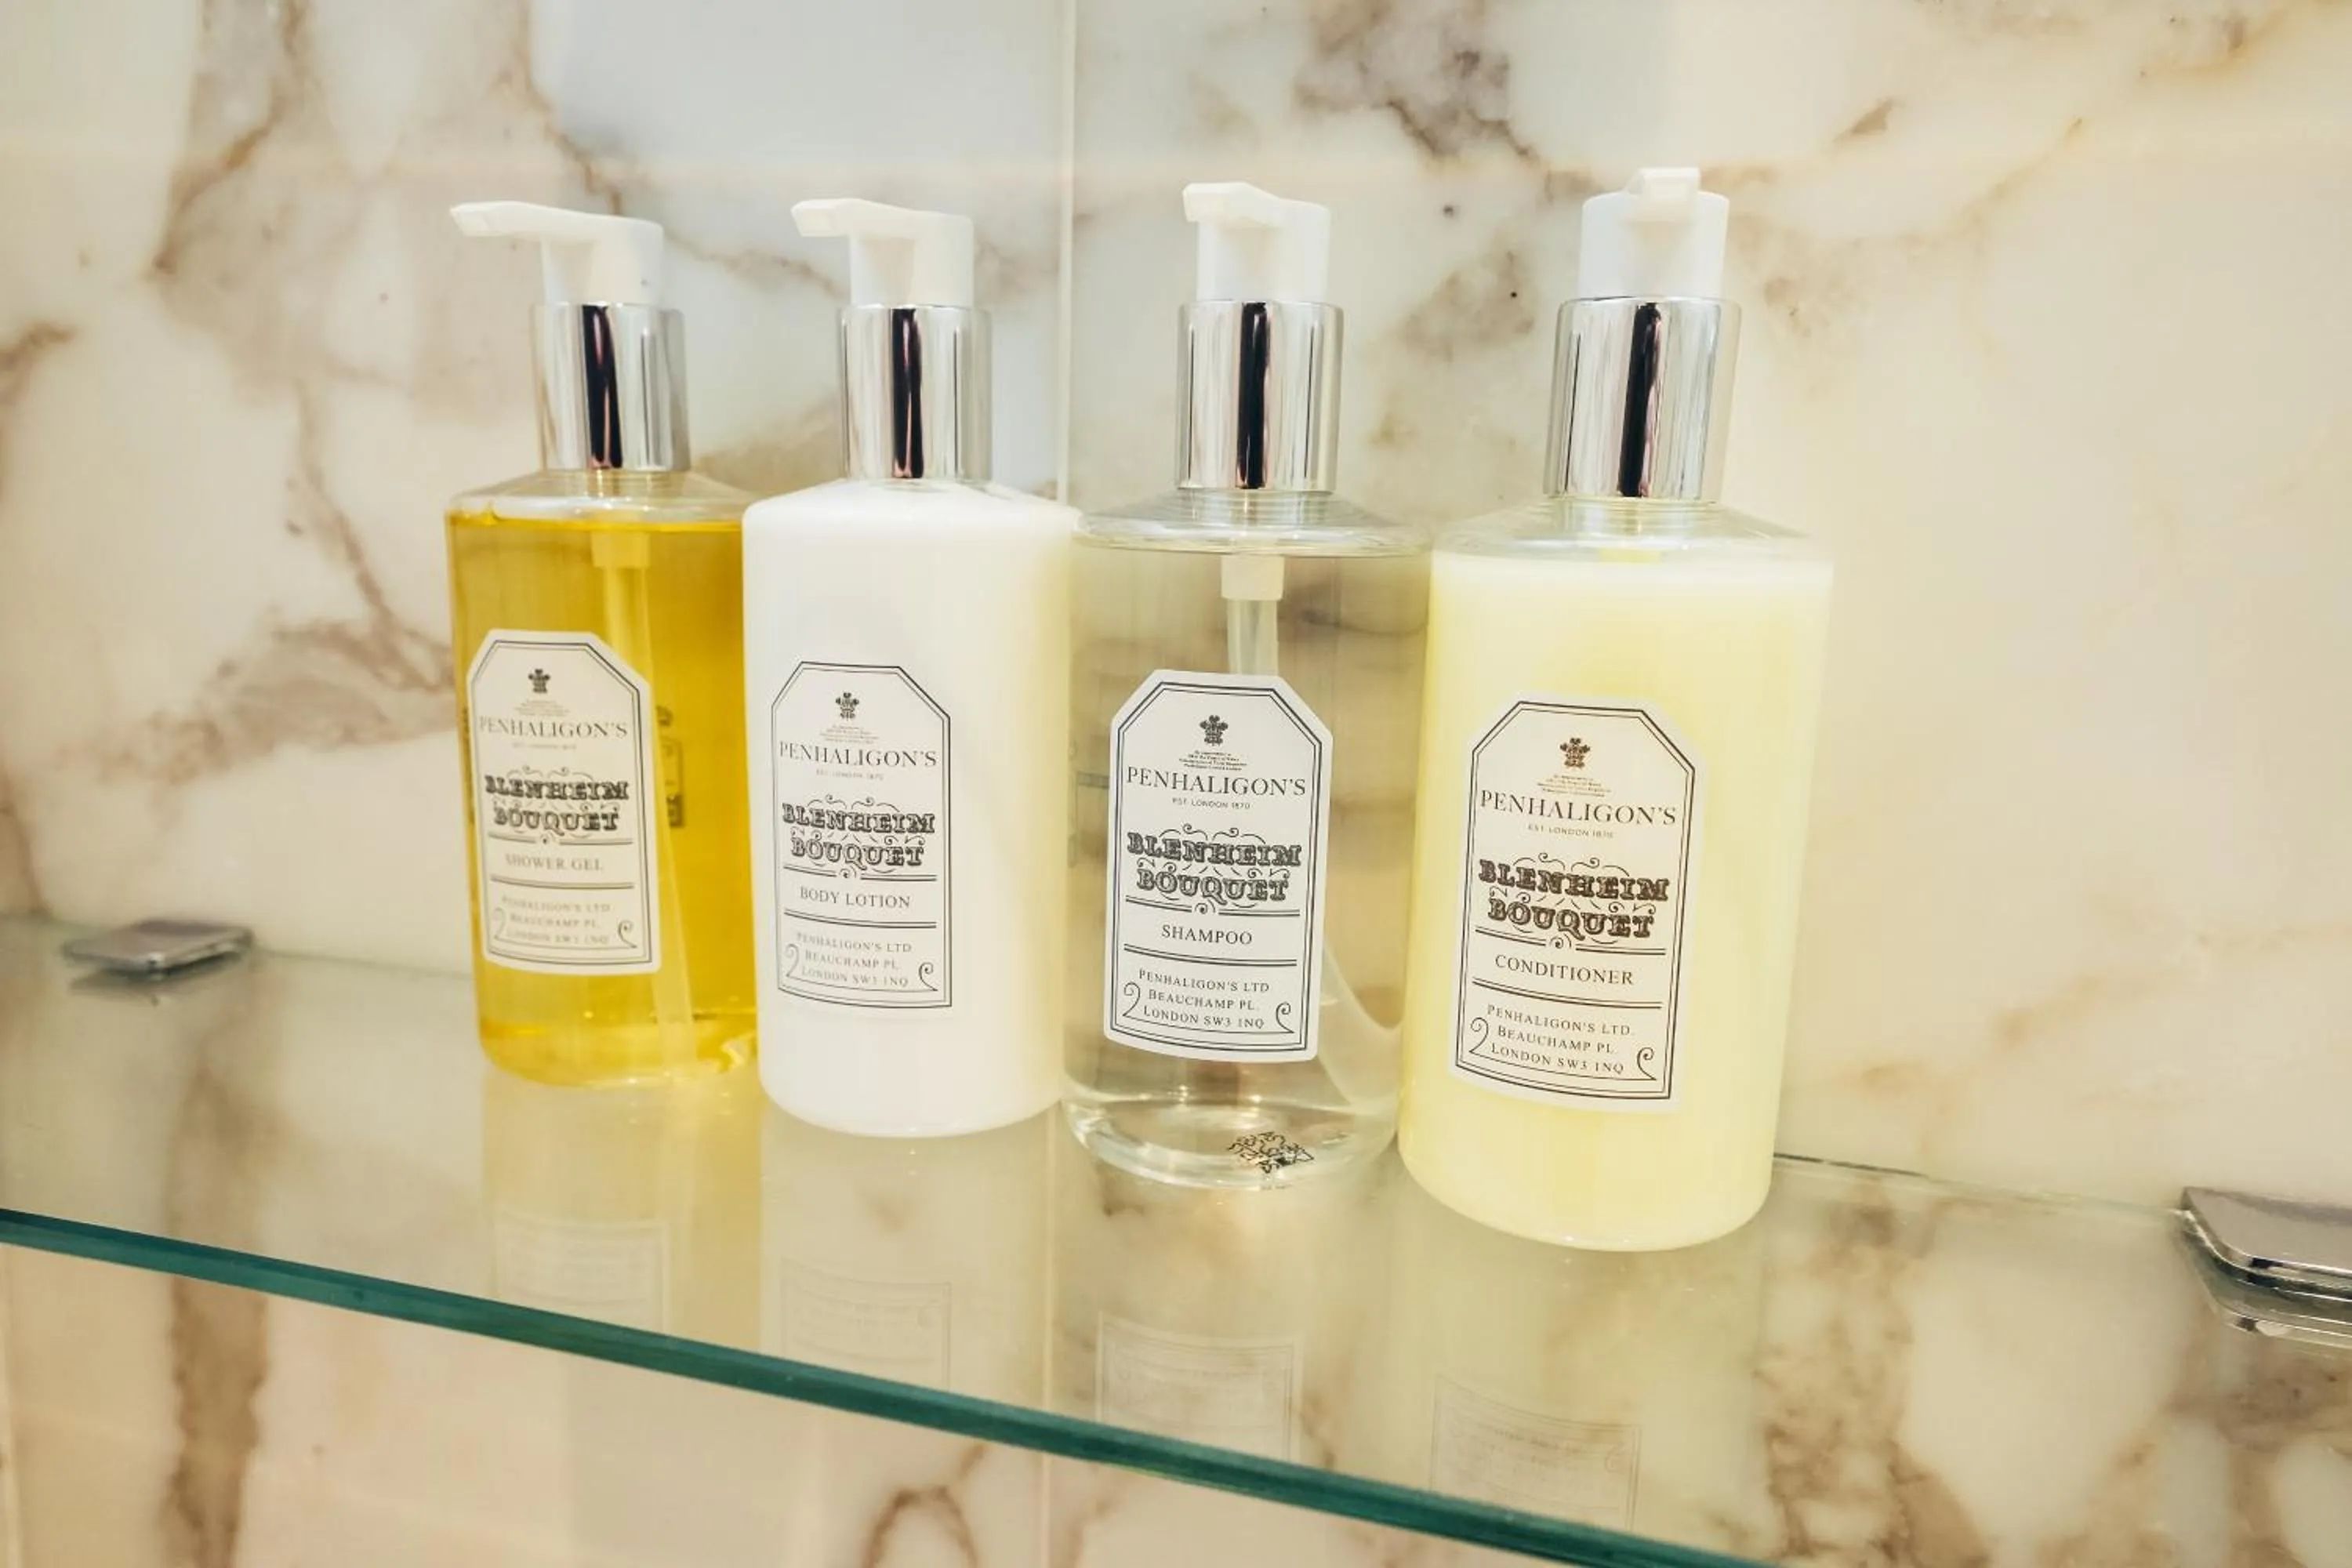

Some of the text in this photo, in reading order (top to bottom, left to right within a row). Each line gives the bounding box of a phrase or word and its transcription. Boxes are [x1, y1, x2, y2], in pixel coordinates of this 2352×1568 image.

[480, 716, 627, 739] PENHALIGON'S
[779, 741, 937, 767] PENHALIGON'S
[485, 775, 630, 800] BLENHEIM
[1127, 766, 1305, 796] PENHALIGON'S
[1191, 798, 1228, 808] LONDON
[1481, 789, 1676, 825] PENHALIGON'S
[494, 807, 619, 836] BOUQUET
[782, 802, 935, 833] BLENHEIM
[1549, 826, 1589, 837] LONDON
[505, 853, 603, 871] SHOWER GEL
[790, 837, 924, 871] BOUQUET
[1127, 832, 1301, 867] BLENHEIM
[1137, 867, 1289, 906] BOUQUET
[1479, 859, 1670, 902] BLENHEIM
[800, 886, 911, 909] BODY LOTION
[1488, 898, 1654, 941] BOUQUET
[797, 932, 882, 951] PENHALIGON'S
[1161, 924, 1252, 945] SHAMPOO
[805, 949, 879, 968] BEAUCHAMP
[1495, 954, 1634, 985] CONDITIONER
[1138, 968, 1238, 992] PENHALIGON'S
[1149, 989, 1234, 1009] BEAUCHAMP
[1144, 1005, 1199, 1024] LONDON
[1203, 1014, 1231, 1028] SW3
[1487, 1004, 1595, 1033] PENHALIGON'S
[1498, 1025, 1591, 1051] BEAUCHAMP
[1491, 1043, 1550, 1065] LONDON
